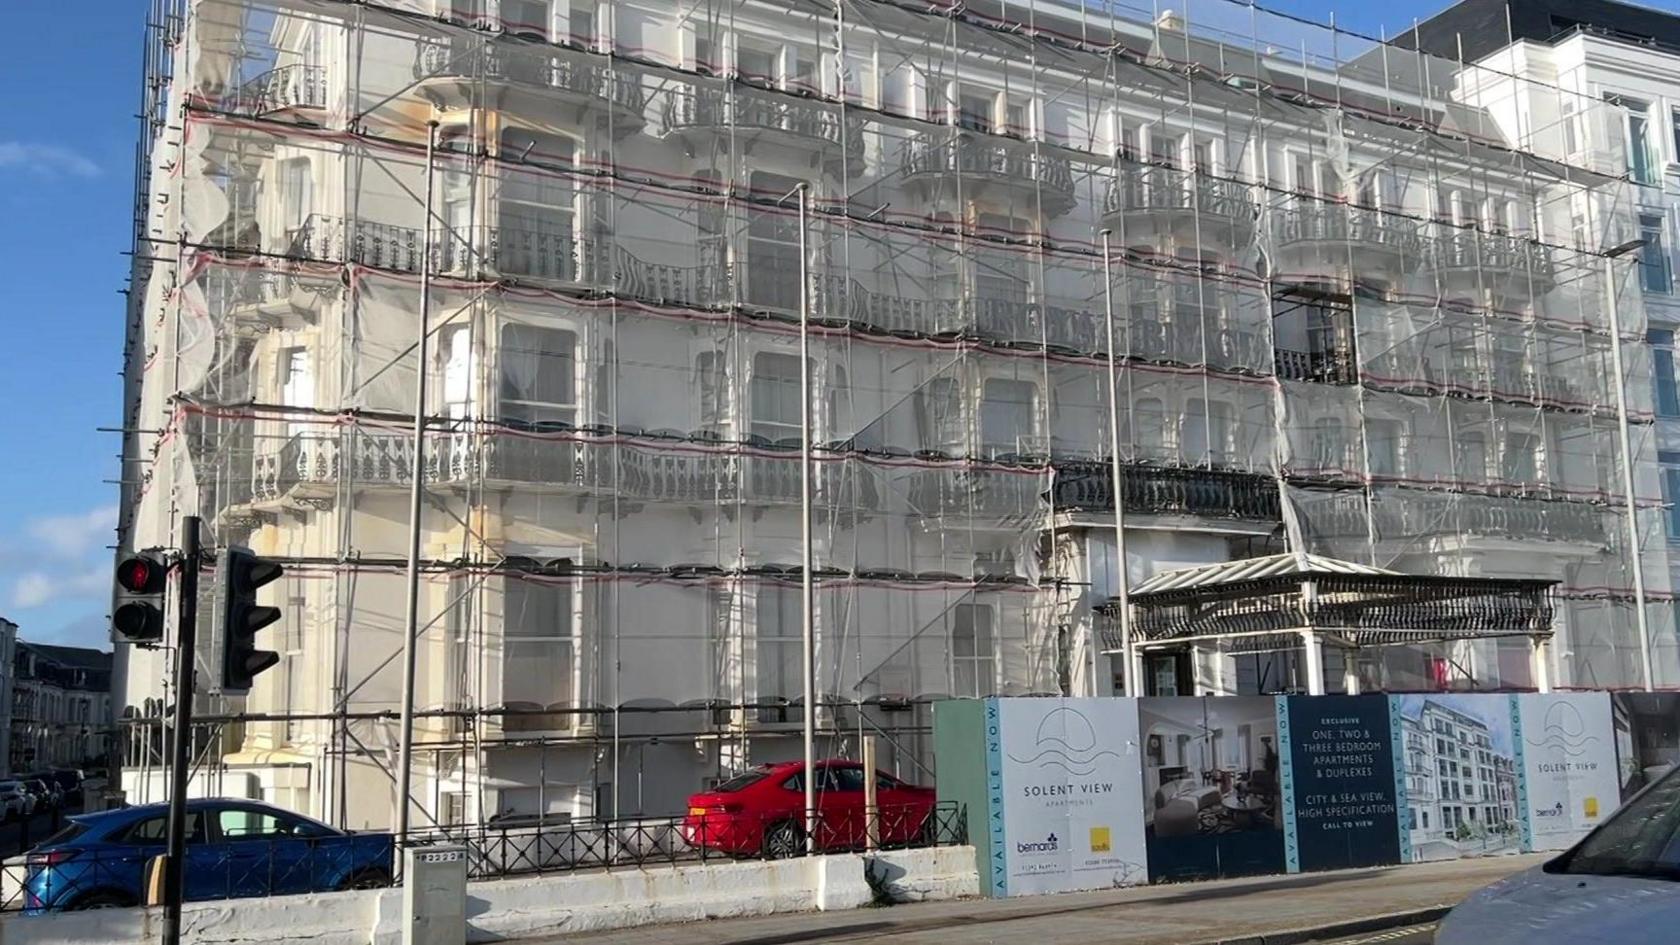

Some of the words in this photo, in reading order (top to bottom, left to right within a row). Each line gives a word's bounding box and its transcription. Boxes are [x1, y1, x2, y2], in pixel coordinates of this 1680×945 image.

[1278, 703, 1288, 744] NOW
[1391, 703, 1400, 741] NOW
[1511, 701, 1521, 737] NOW
[988, 707, 998, 752] NOW
[1339, 730, 1361, 739] TWO
[1364, 729, 1370, 738] &
[1302, 743, 1332, 753] THREE
[1336, 742, 1381, 752] BEDROOM
[1313, 754, 1374, 765] APARTMENTS
[1325, 767, 1373, 778] DUPLEXES
[1538, 763, 1571, 773] SOLENT
[1575, 762, 1599, 770] VIEW
[1023, 784, 1074, 797] SOLENT
[1080, 783, 1113, 794] VIEW
[1305, 794, 1328, 805] CITY
[1331, 794, 1337, 803] &
[1340, 793, 1357, 803] SEA
[1283, 761, 1297, 865] AVAILABLE
[1298, 808, 1323, 818] HIGH
[1325, 804, 1395, 817] SPECIFICATION
[991, 770, 1005, 888] AVAILABLE
[1322, 822, 1340, 830] CALL
[1343, 821, 1353, 829] TO
[1017, 841, 1058, 853] bernards
